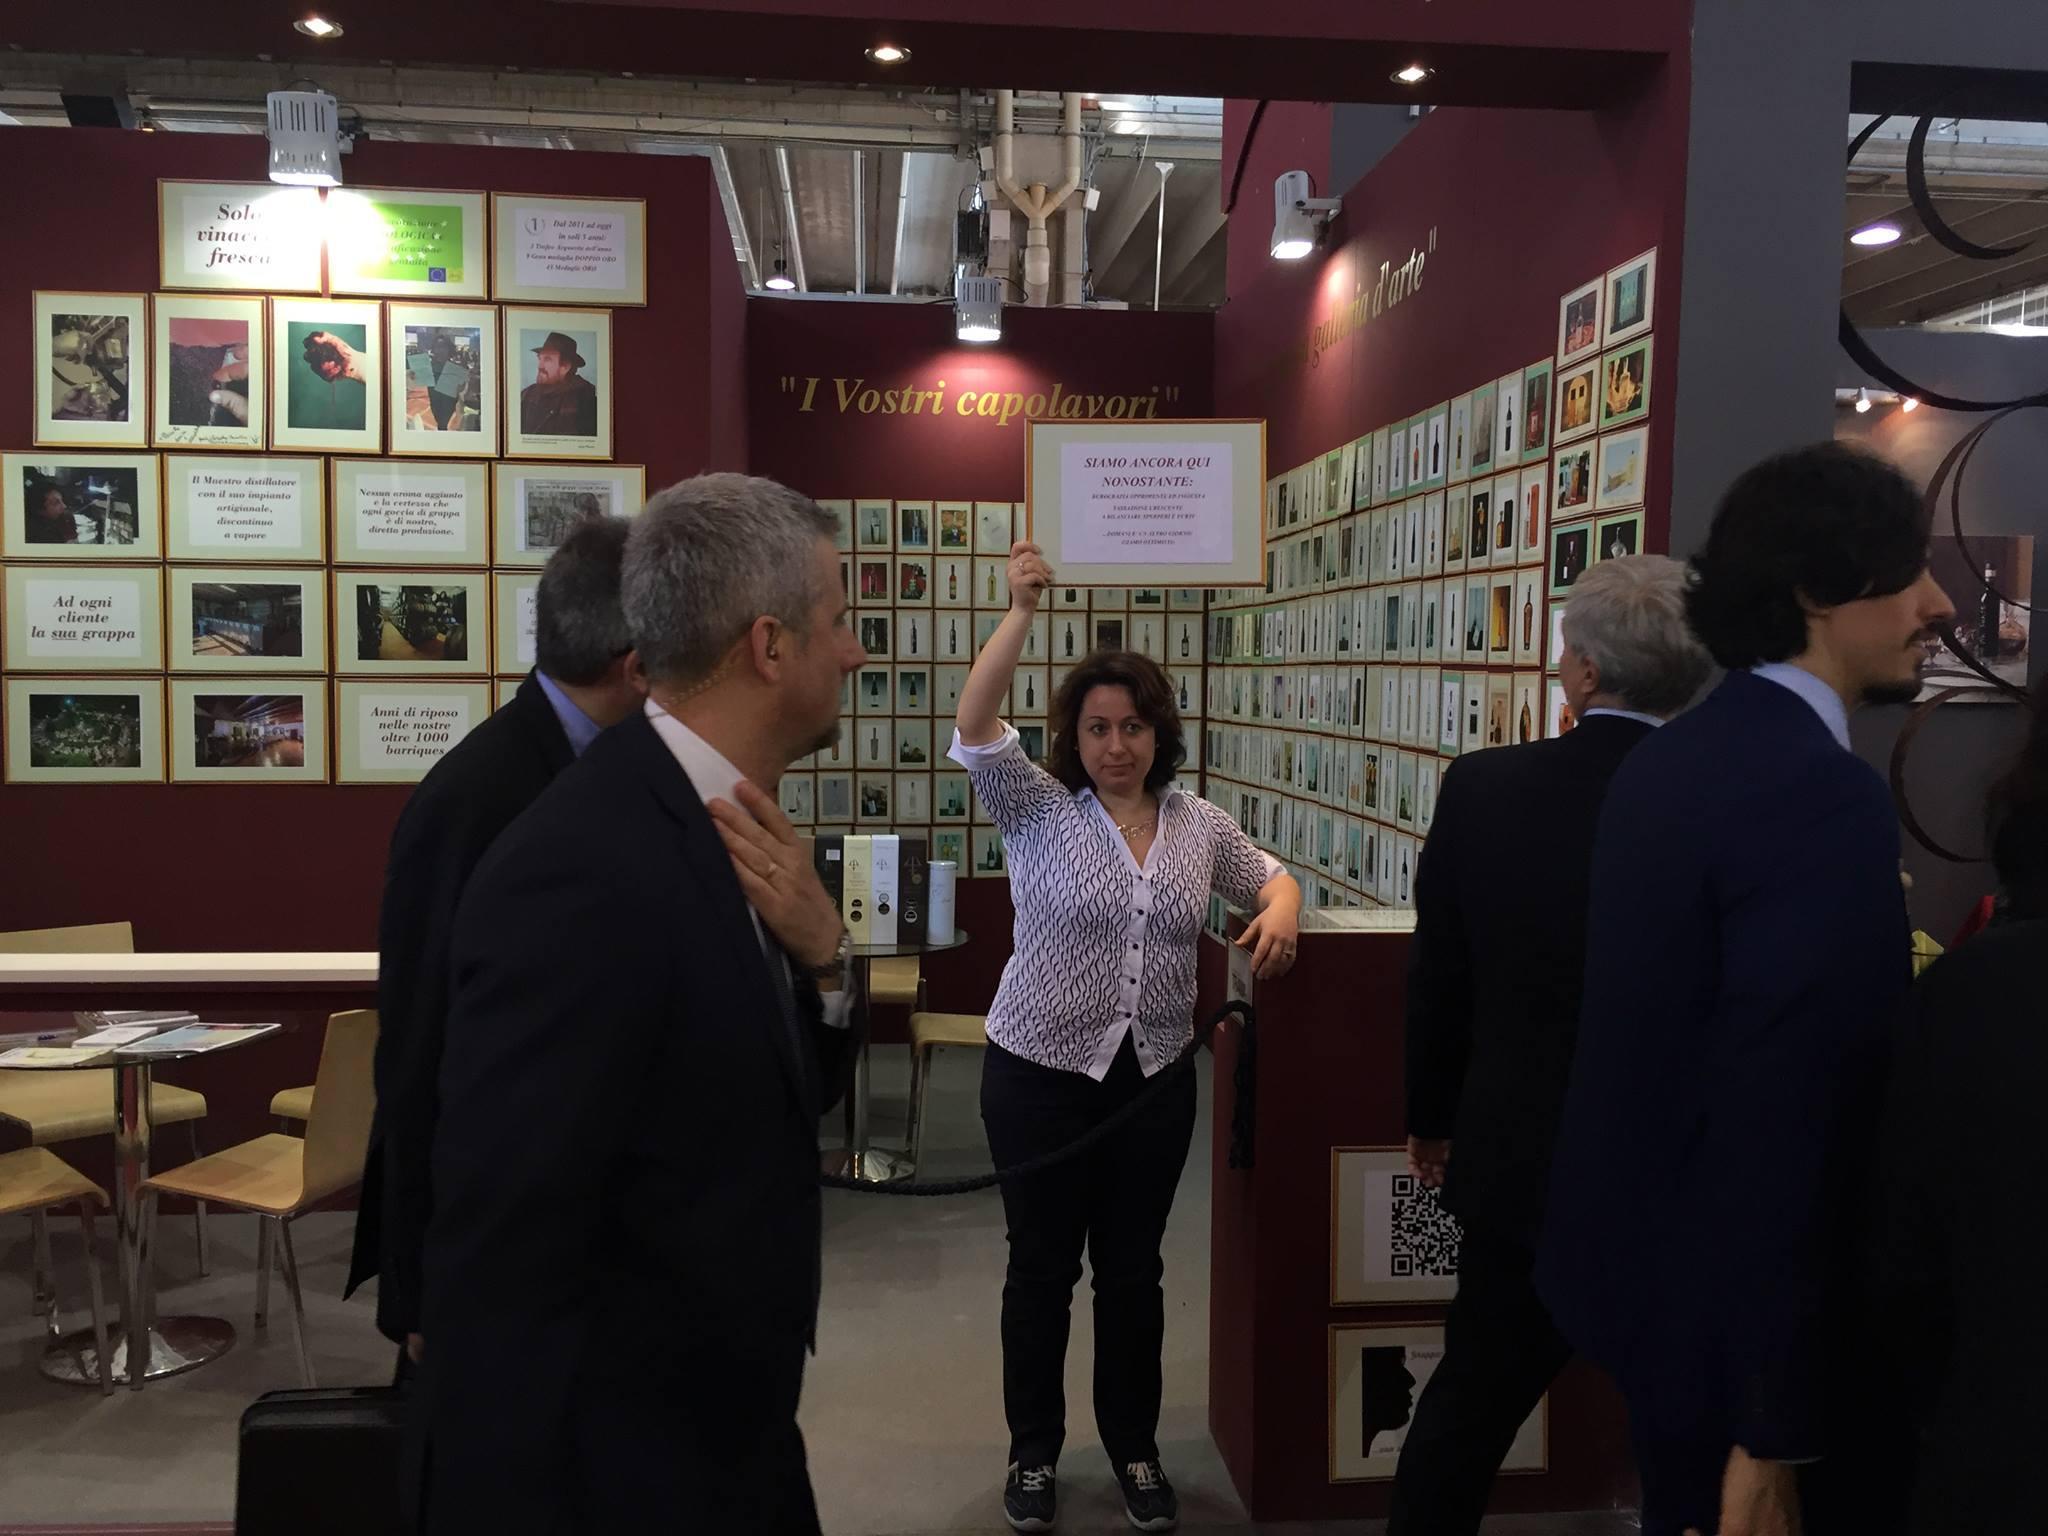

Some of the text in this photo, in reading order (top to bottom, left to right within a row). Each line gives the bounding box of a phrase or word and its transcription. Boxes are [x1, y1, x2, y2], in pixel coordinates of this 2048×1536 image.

[553, 220, 567, 228] Dal
[833, 378, 946, 416] Vostri
[957, 382, 1180, 426] capolavori"
[1084, 457, 1211, 469] SIAMO ANCORA QUI
[192, 475, 296, 486] Il Maestro distillatore
[1102, 476, 1194, 487] NONOSTANTE:
[219, 490, 226, 498] il
[248, 490, 291, 501] impianto
[360, 488, 391, 497] Nessun
[424, 491, 463, 500] aggiunto
[382, 498, 391, 506] la
[433, 499, 449, 507] che
[362, 508, 460, 518] ogni goccia di grappa
[216, 517, 273, 526] discontinuo
[394, 517, 403, 525] di
[368, 526, 399, 534] diretta
[234, 532, 267, 541] vapore
[53, 595, 112, 611] Ad ogni
[58, 610, 109, 623] cliente
[31, 626, 135, 642] la sua grappa
[371, 706, 459, 719] Anni di riposo
[379, 719, 451, 730] nelle nostre
[381, 731, 449, 743] oltre 1000
[385, 744, 445, 758] barriques
